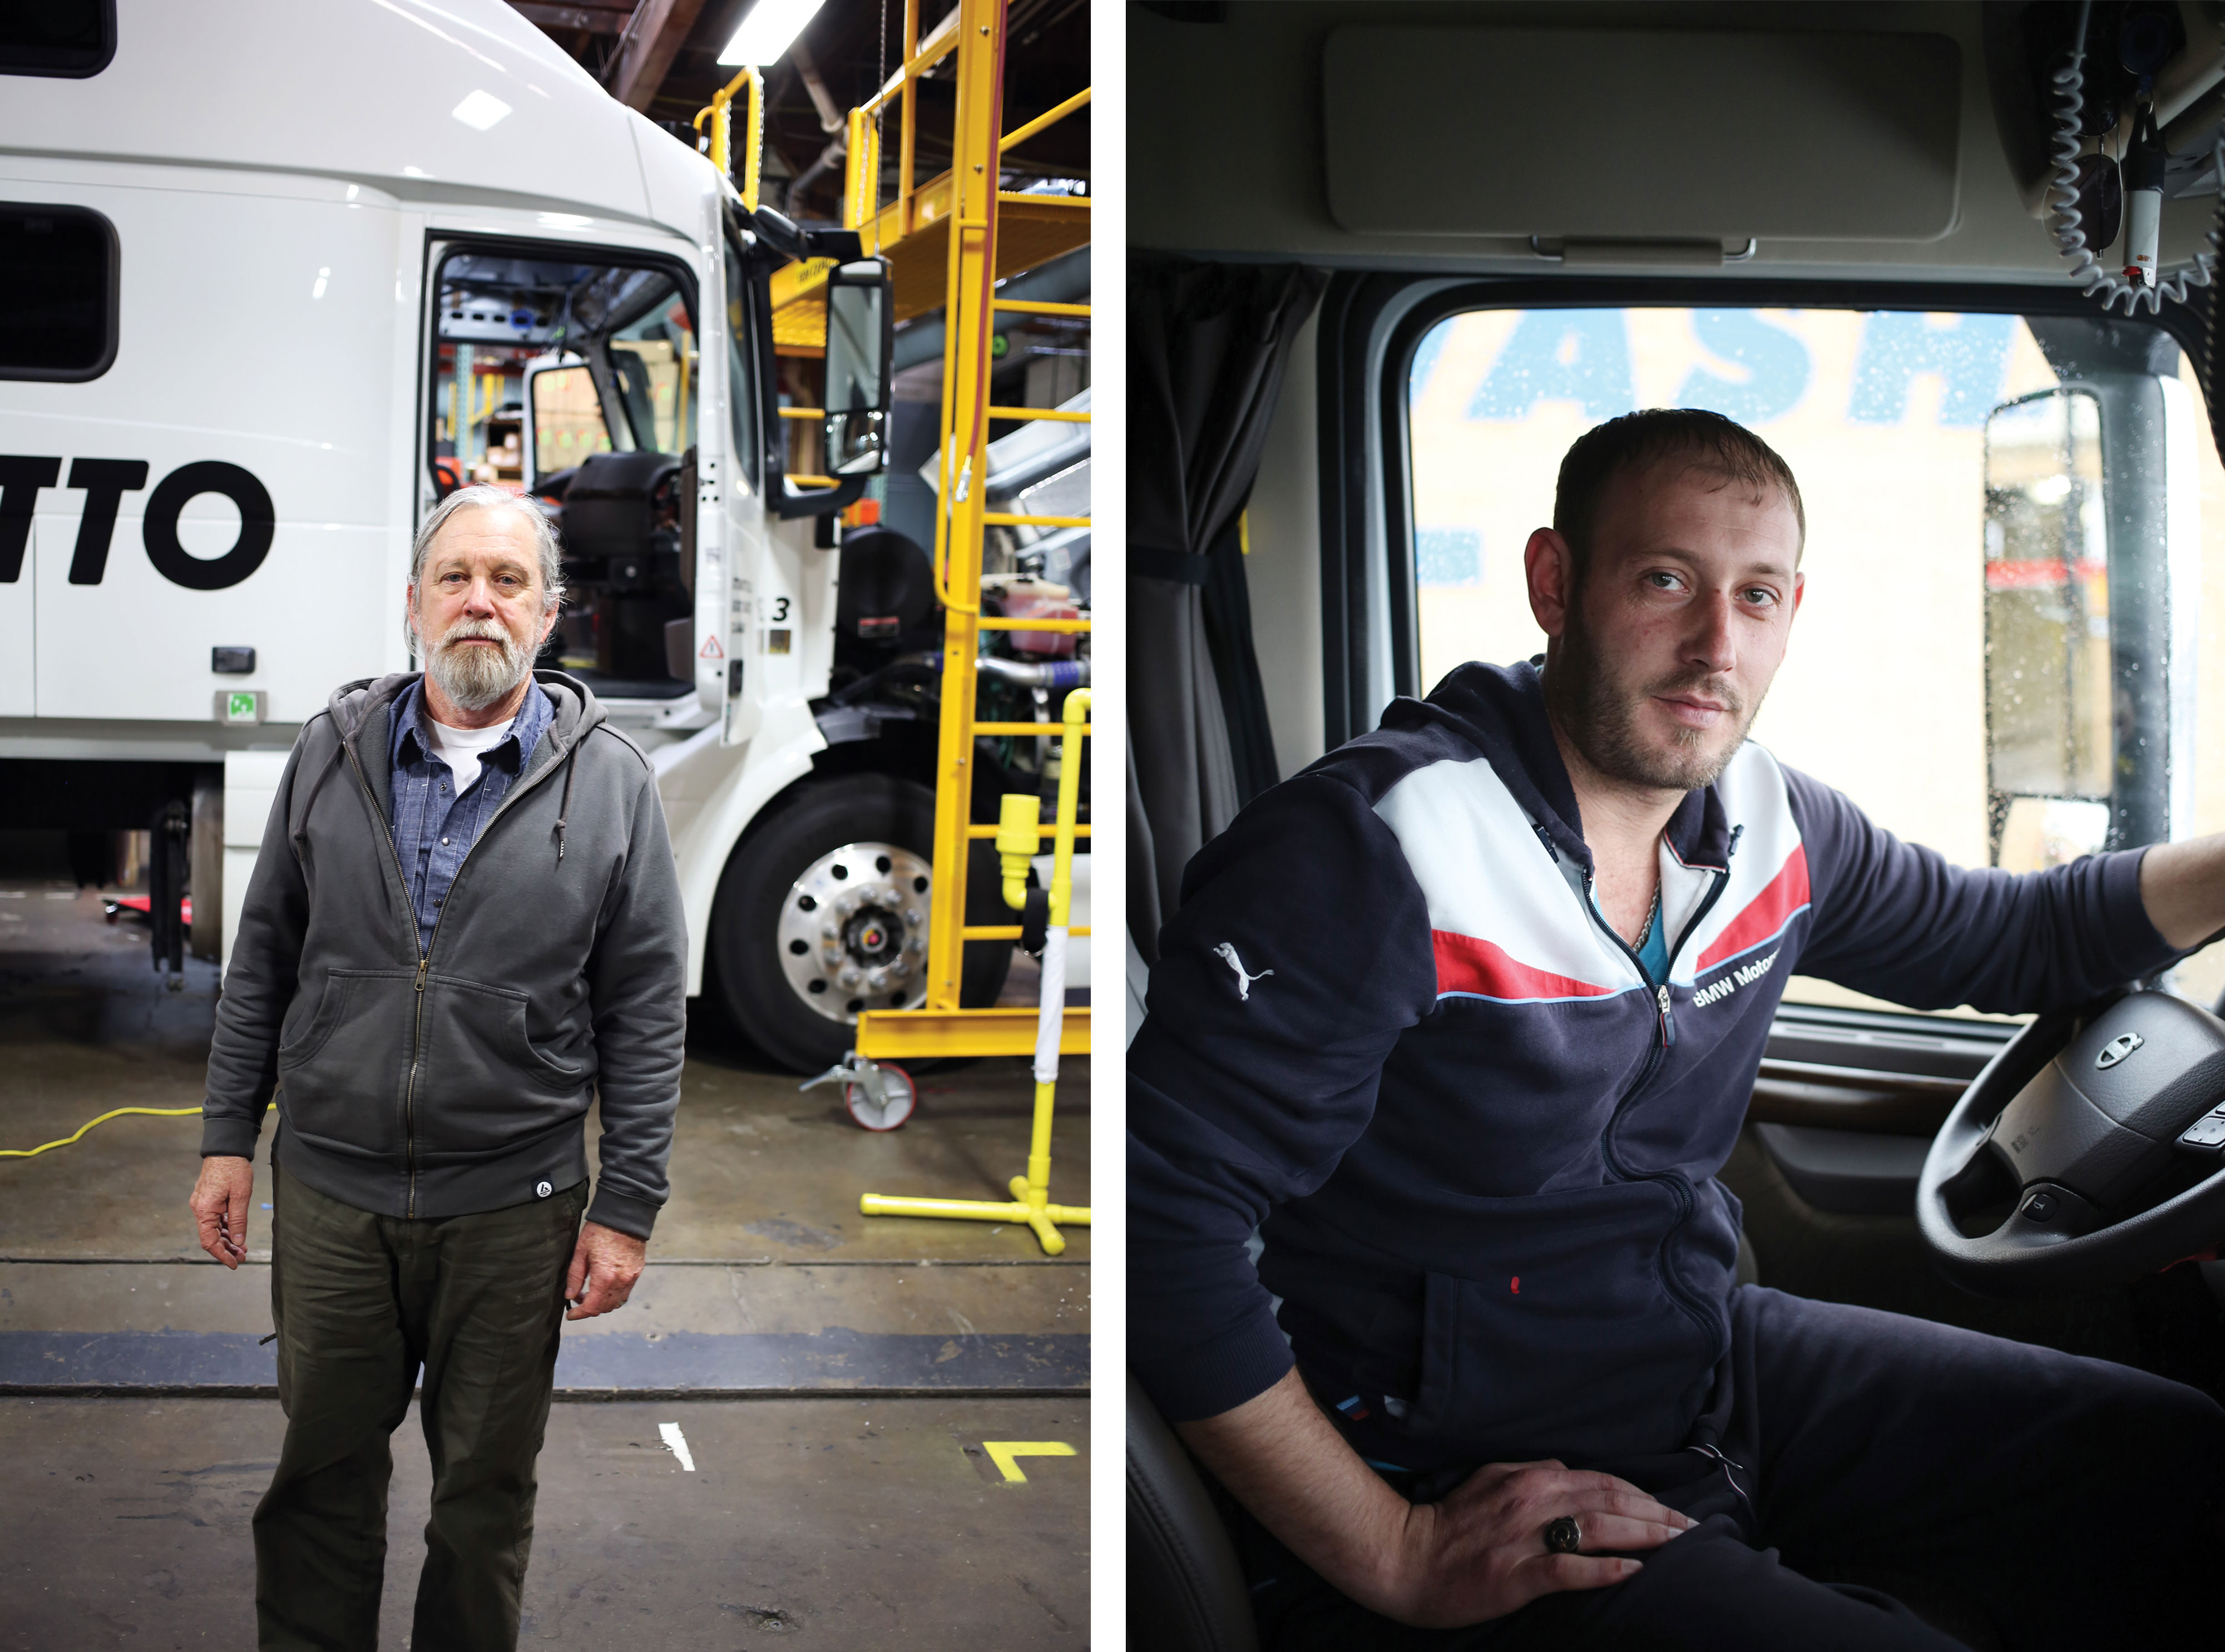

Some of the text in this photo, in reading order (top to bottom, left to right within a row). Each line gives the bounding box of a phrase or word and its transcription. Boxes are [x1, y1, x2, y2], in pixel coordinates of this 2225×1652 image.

[1410, 308, 2018, 425] ASH
[772, 597, 790, 622] 3
[1693, 946, 1781, 1007] BMW Motor
